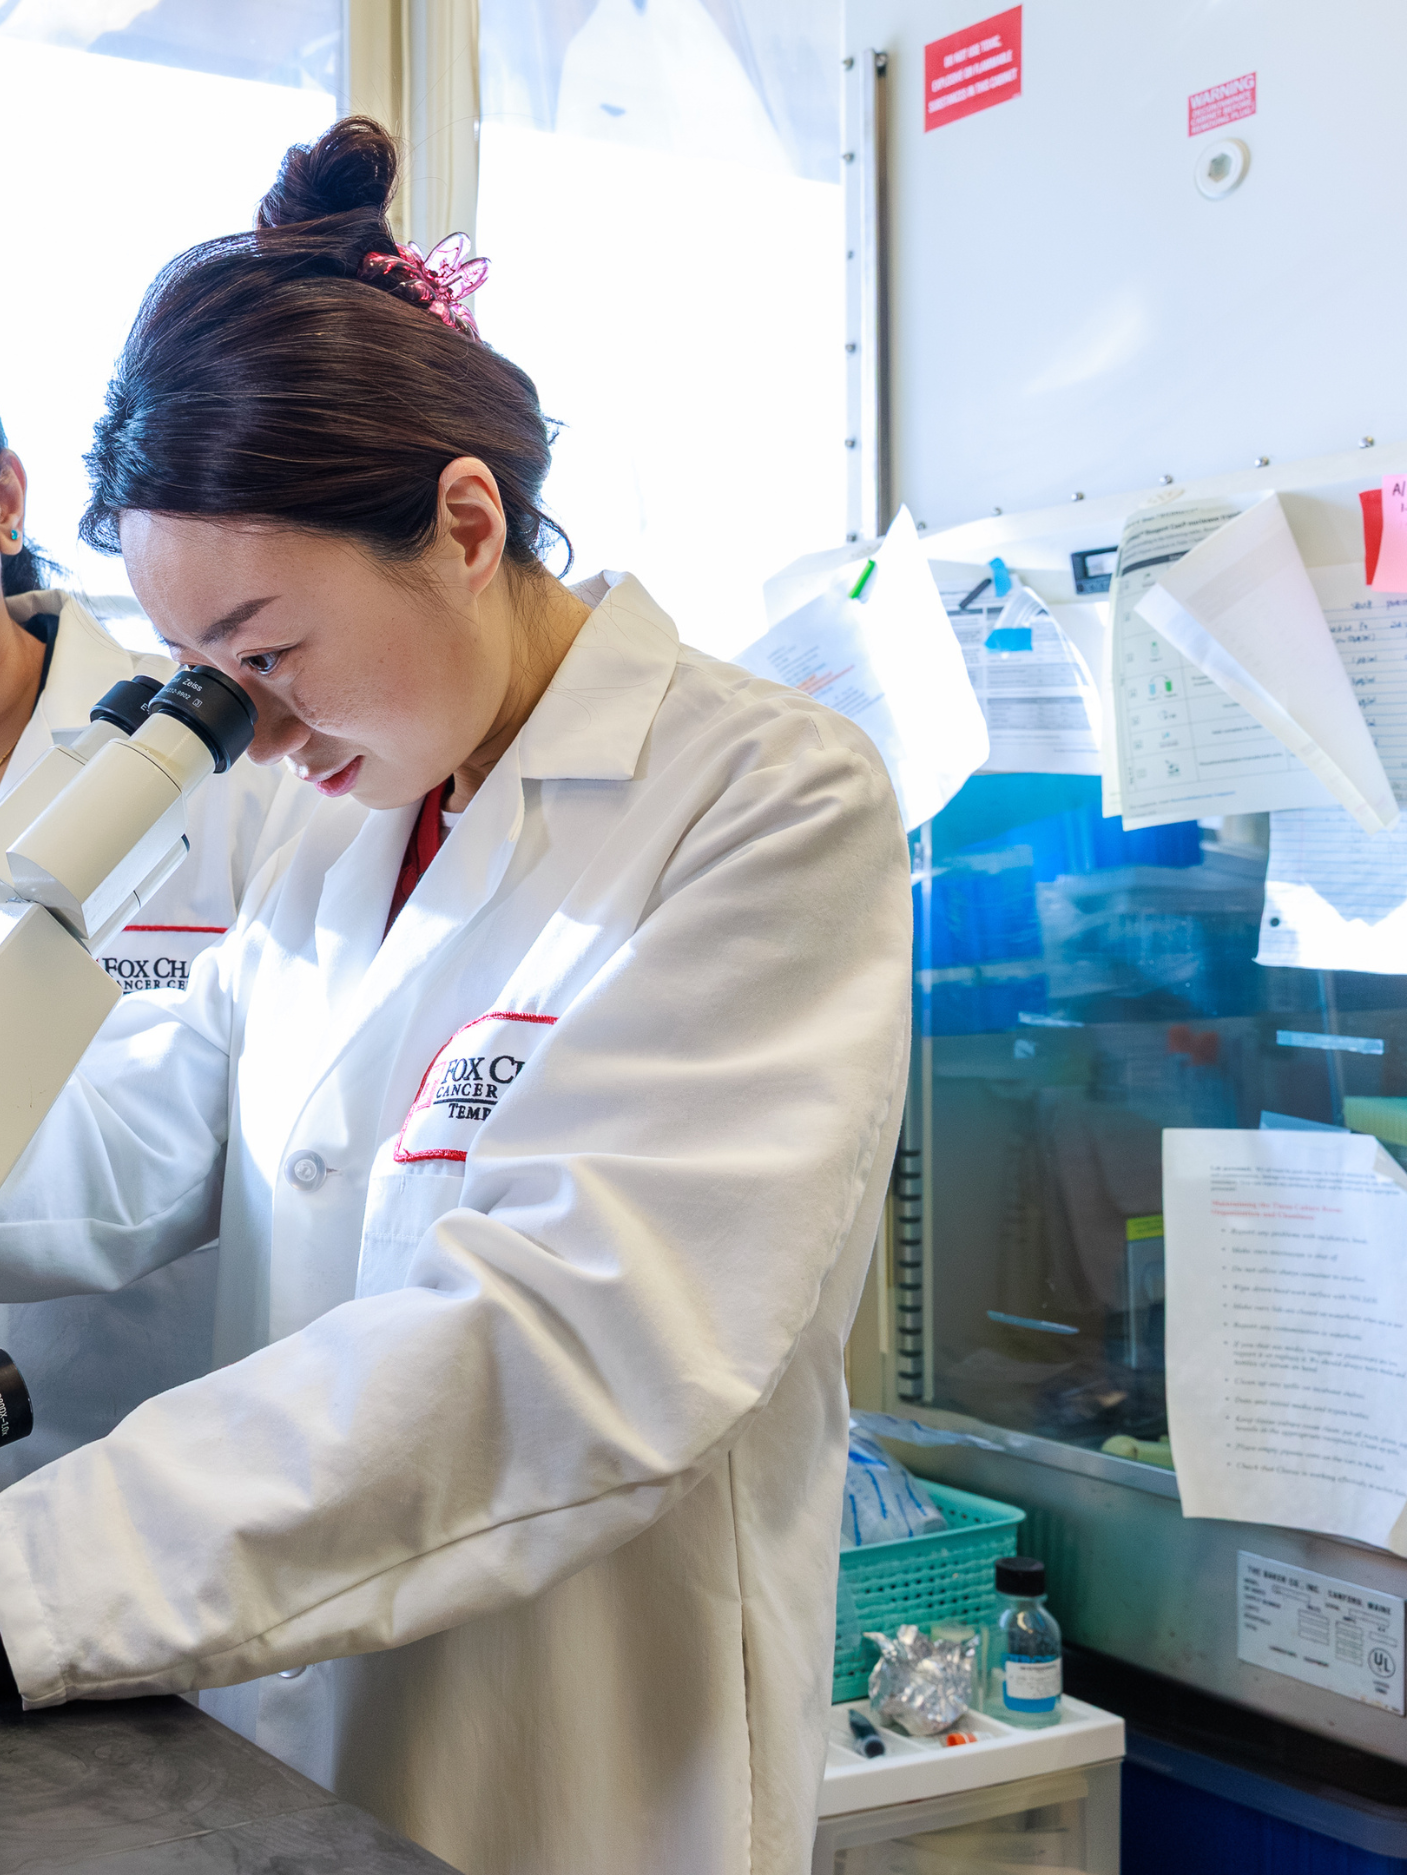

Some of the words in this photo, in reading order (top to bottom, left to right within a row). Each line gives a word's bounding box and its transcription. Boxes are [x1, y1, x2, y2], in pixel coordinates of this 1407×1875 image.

[1191, 75, 1255, 109] WARNING
[182, 678, 203, 692] Zeiss
[102, 957, 150, 979] FOX
[153, 957, 189, 979] CH
[167, 980, 188, 989] CE
[441, 1057, 485, 1084] FOX
[436, 1083, 498, 1099] CANCER
